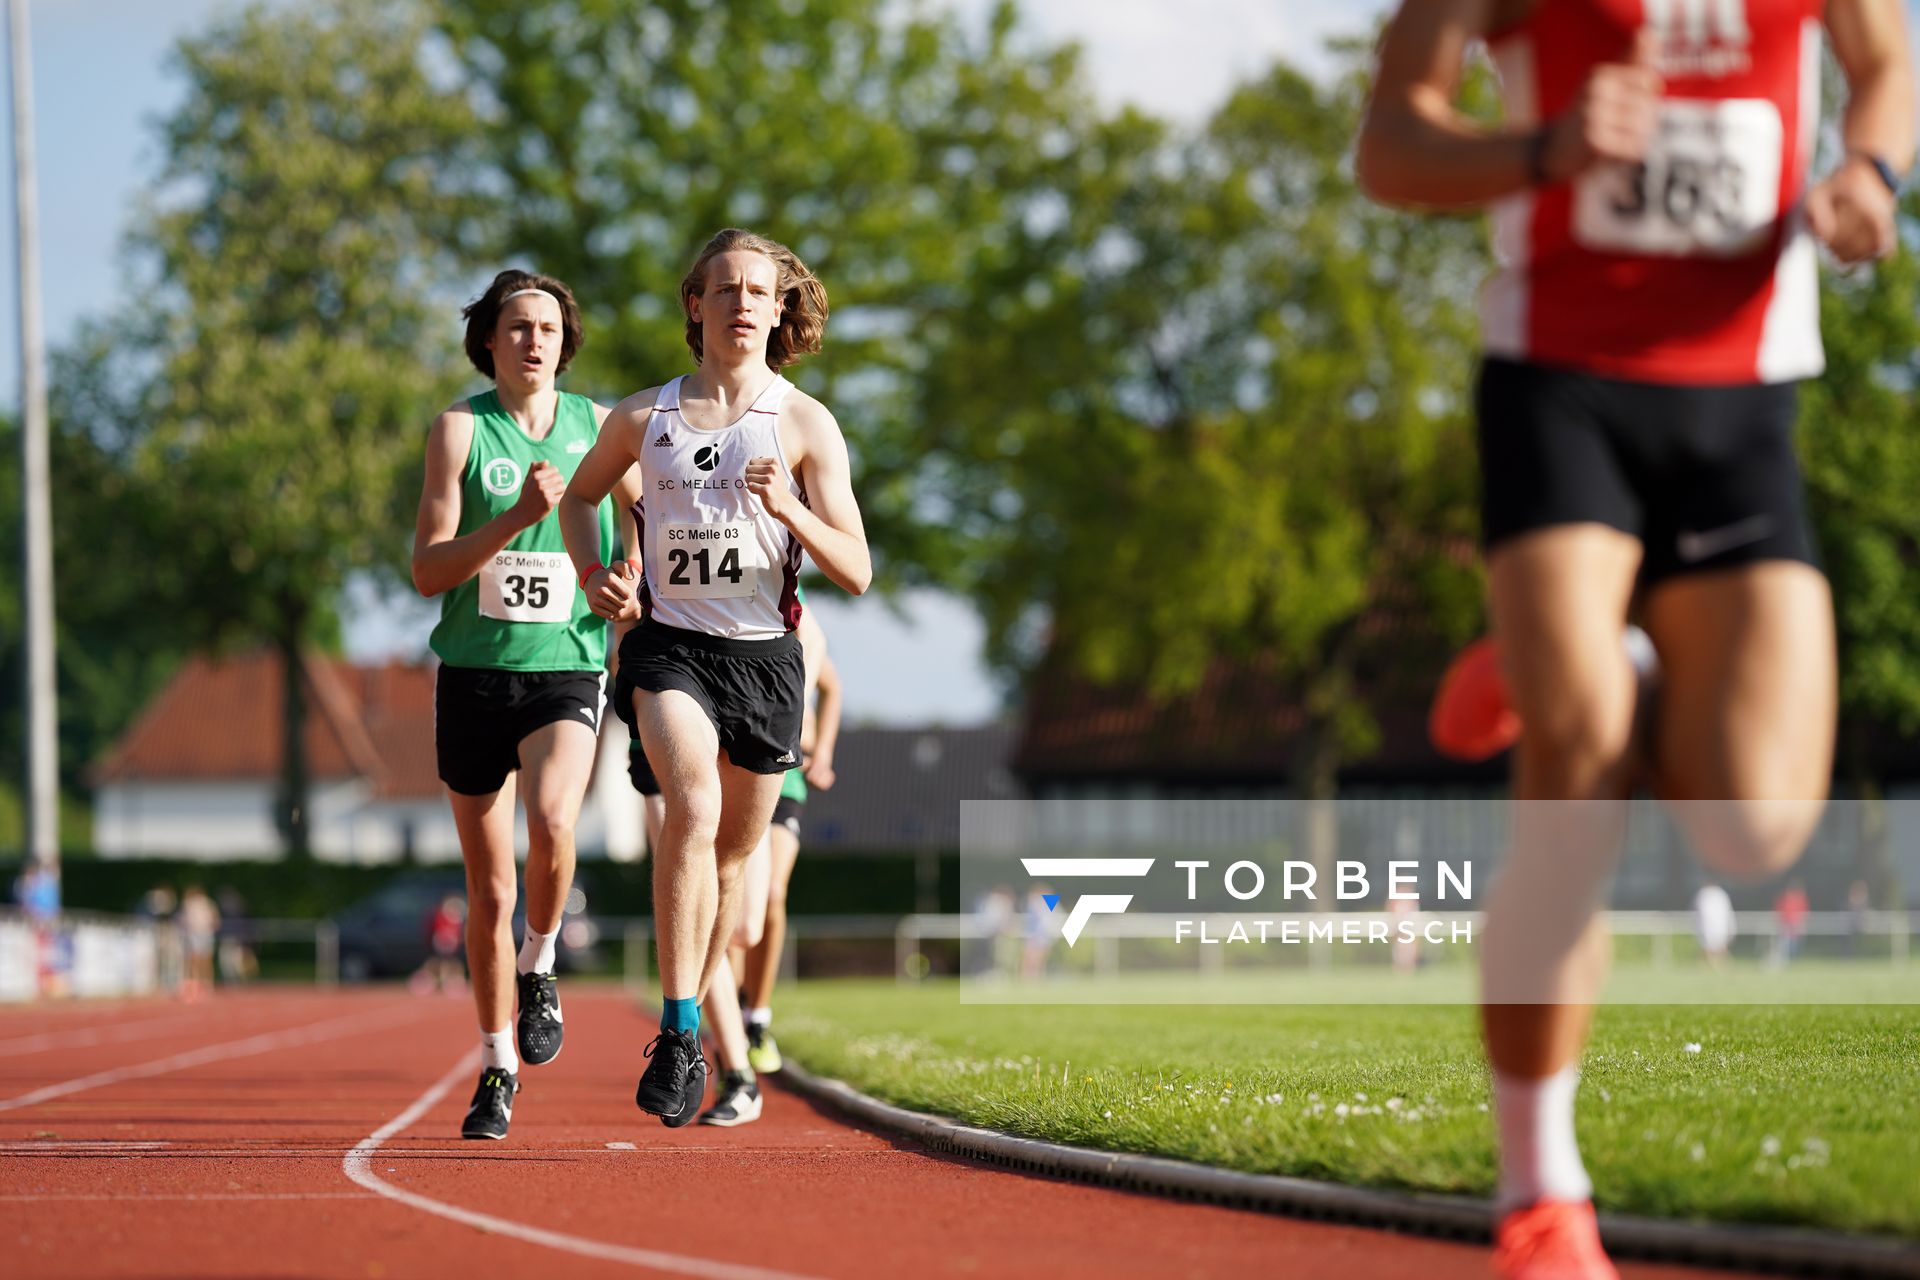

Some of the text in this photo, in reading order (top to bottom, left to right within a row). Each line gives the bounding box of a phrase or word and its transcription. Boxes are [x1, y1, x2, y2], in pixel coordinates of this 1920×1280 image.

[658, 480, 748, 490] SC MELLE O
[669, 528, 739, 540] SC Melle 03
[496, 556, 562, 568] SC Melle 03
[668, 548, 743, 585] 214
[503, 575, 549, 609] 35
